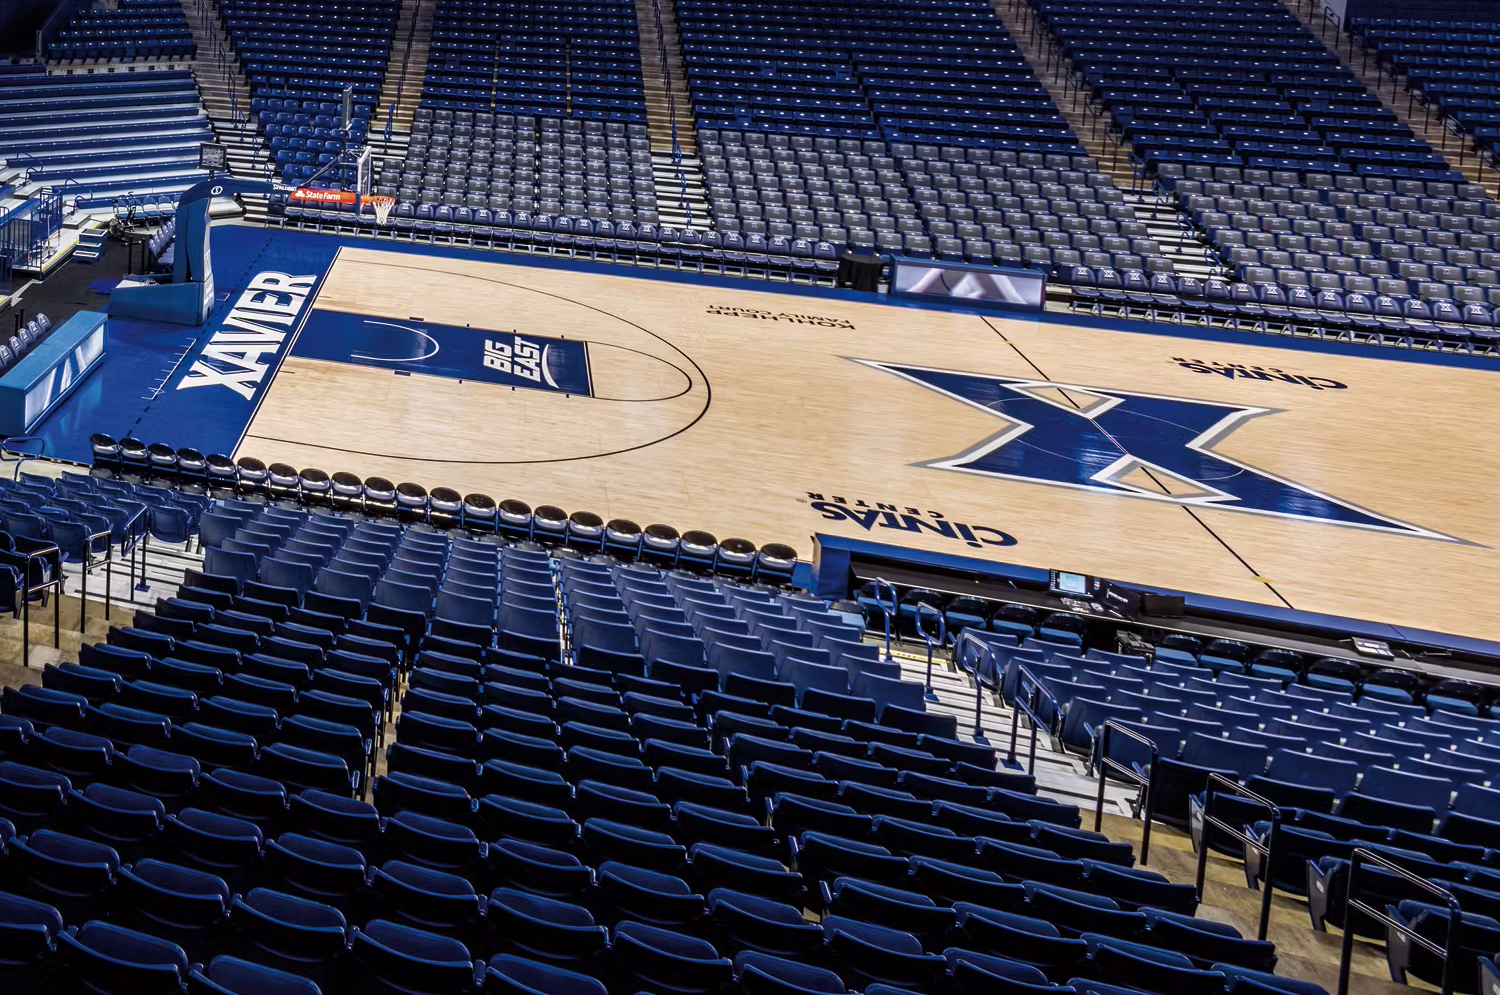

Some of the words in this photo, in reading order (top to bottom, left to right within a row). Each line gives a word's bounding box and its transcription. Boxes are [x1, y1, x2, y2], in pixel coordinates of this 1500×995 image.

[305, 190, 323, 199] State
[323, 192, 340, 200] Farm
[706, 310, 856, 330] KOHLHEPP
[708, 305, 771, 315] COURT
[779, 313, 850, 323] FAMILY
[177, 270, 317, 401] XAVIER
[483, 338, 514, 374] BIG
[512, 336, 542, 383] EAST
[1171, 356, 1284, 373] CENTER
[806, 491, 945, 518] CENTER
